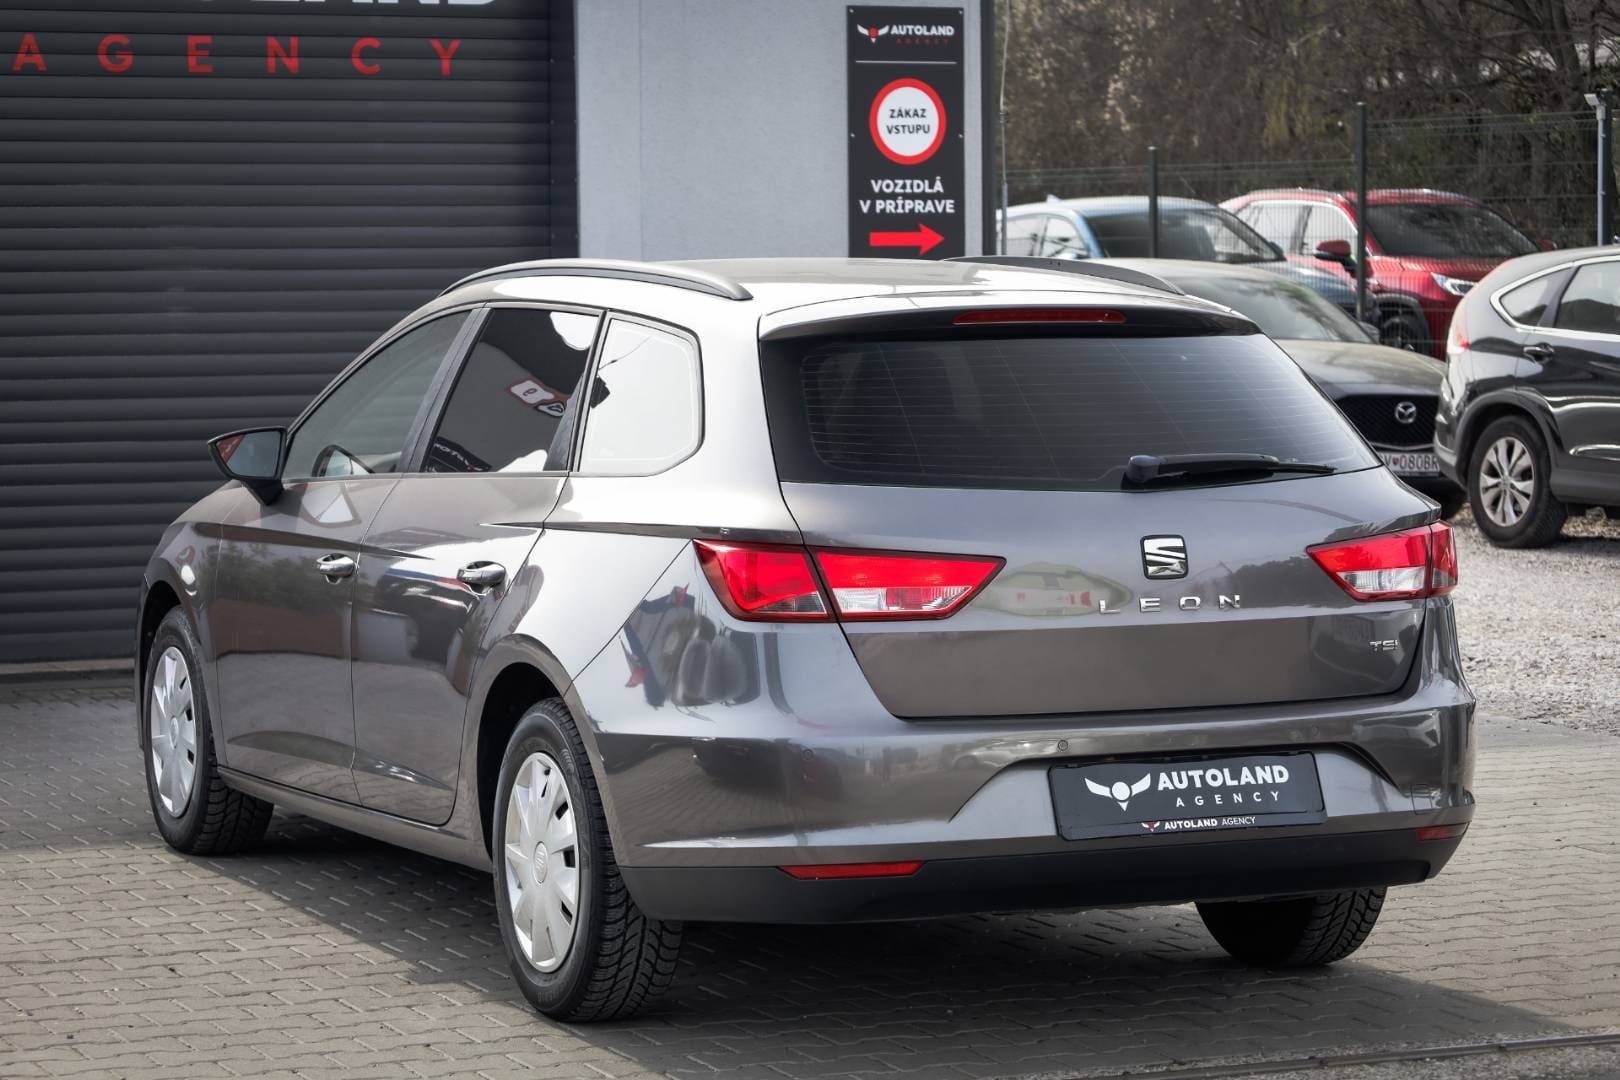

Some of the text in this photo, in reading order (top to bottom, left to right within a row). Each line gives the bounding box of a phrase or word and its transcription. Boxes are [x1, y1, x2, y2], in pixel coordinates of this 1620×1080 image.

[890, 24, 955, 36] AUTOLAND
[12, 32, 463, 77] AGENCY
[889, 107, 927, 119] ZÁKAZ
[886, 124, 931, 135] VSTUPU
[870, 176, 944, 194] VOZIDLÁ
[859, 196, 955, 214] V PRÍPRAVE
[1099, 594, 1241, 615] LEON
[1369, 639, 1400, 652] TSI
[1157, 764, 1290, 791] AUTOLAND
[1175, 791, 1281, 808] AGENCY
[1164, 815, 1257, 831] AUTOLAND AGENCY
